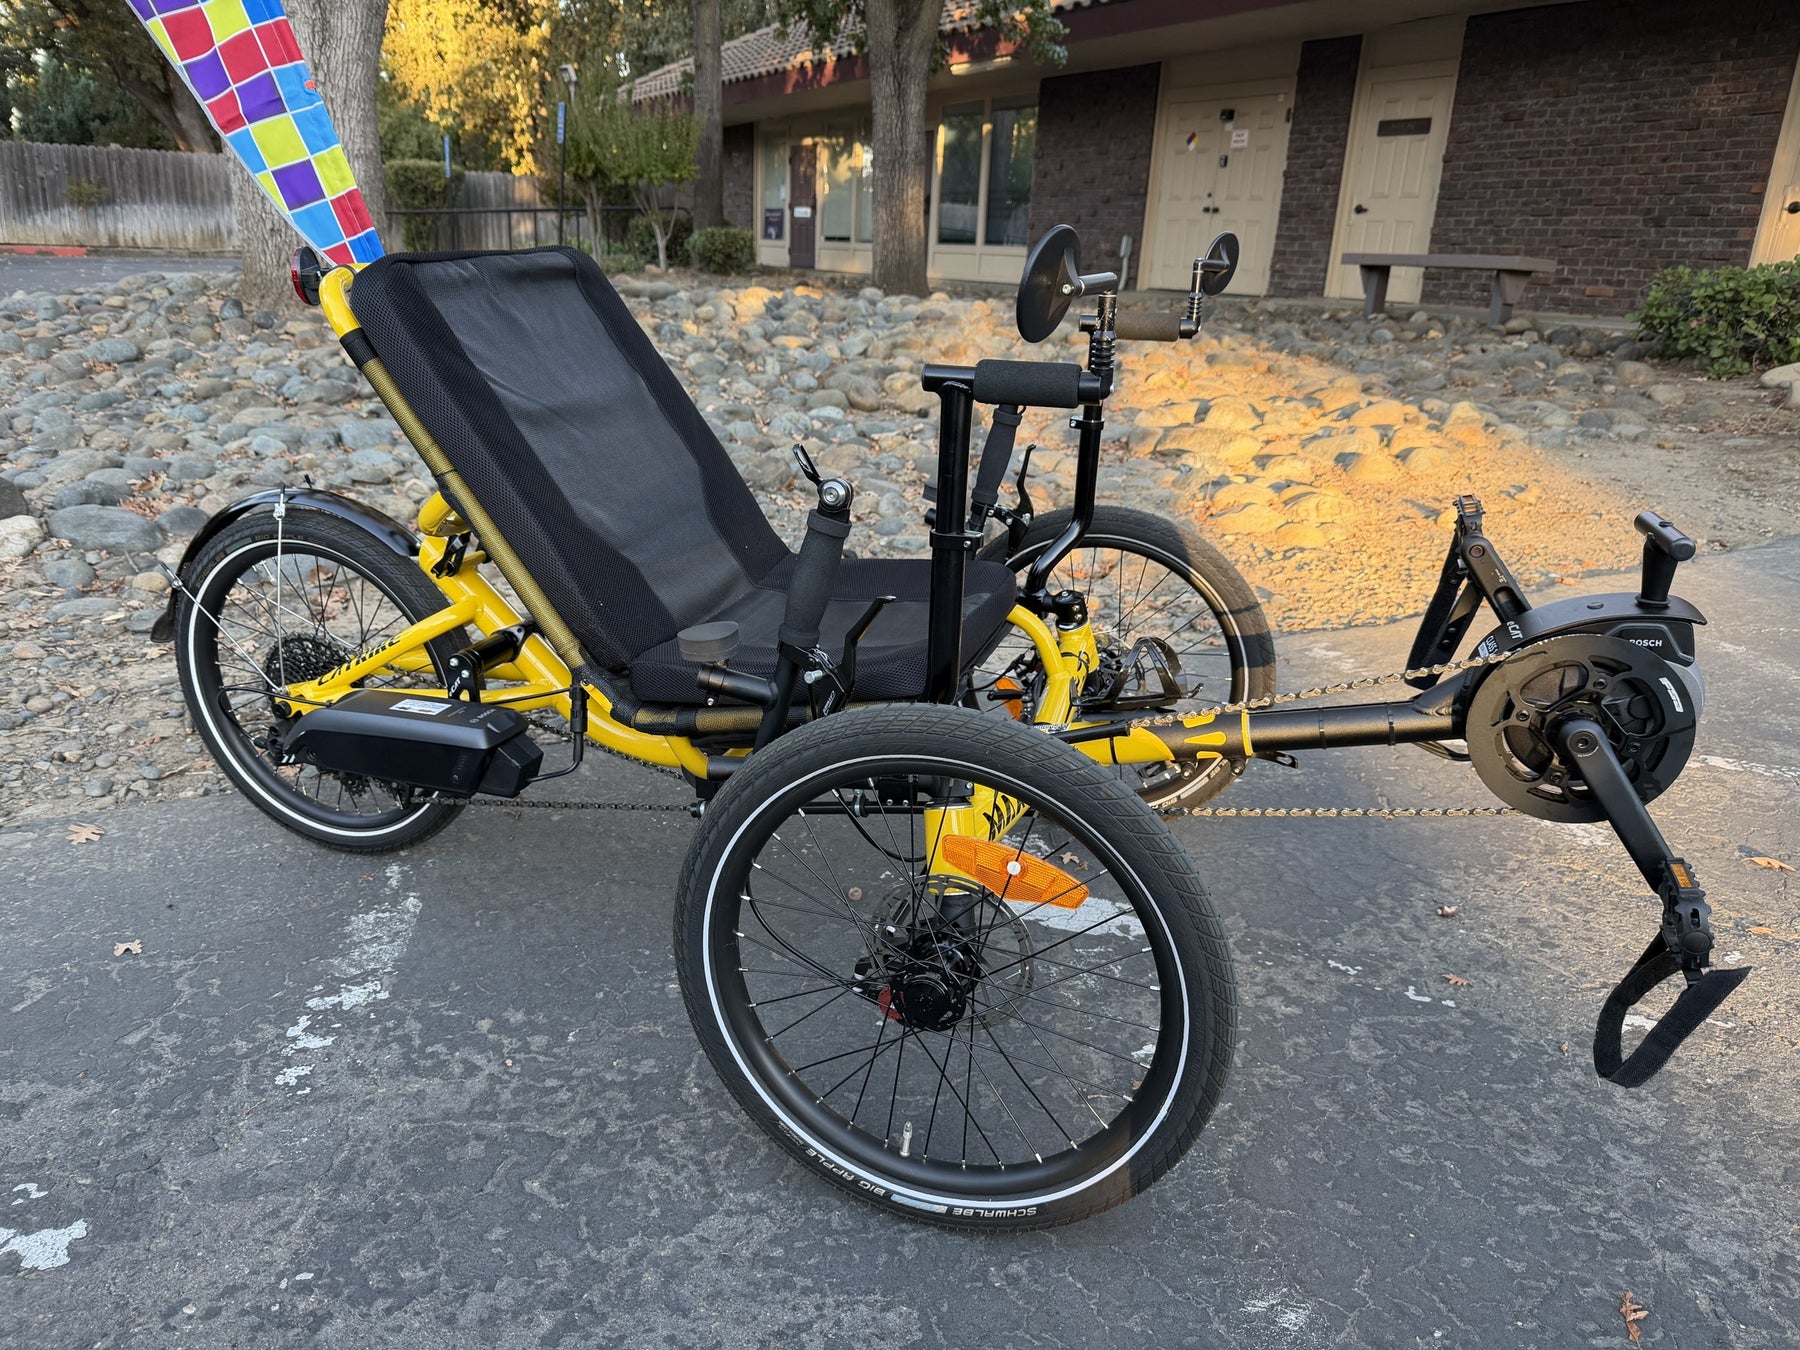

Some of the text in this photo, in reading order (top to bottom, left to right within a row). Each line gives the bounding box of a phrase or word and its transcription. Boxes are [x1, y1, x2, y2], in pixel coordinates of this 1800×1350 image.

[1507, 621, 1523, 639] eCAT
[806, 1148, 1037, 1218] SCHWALBE BIG APPLE
